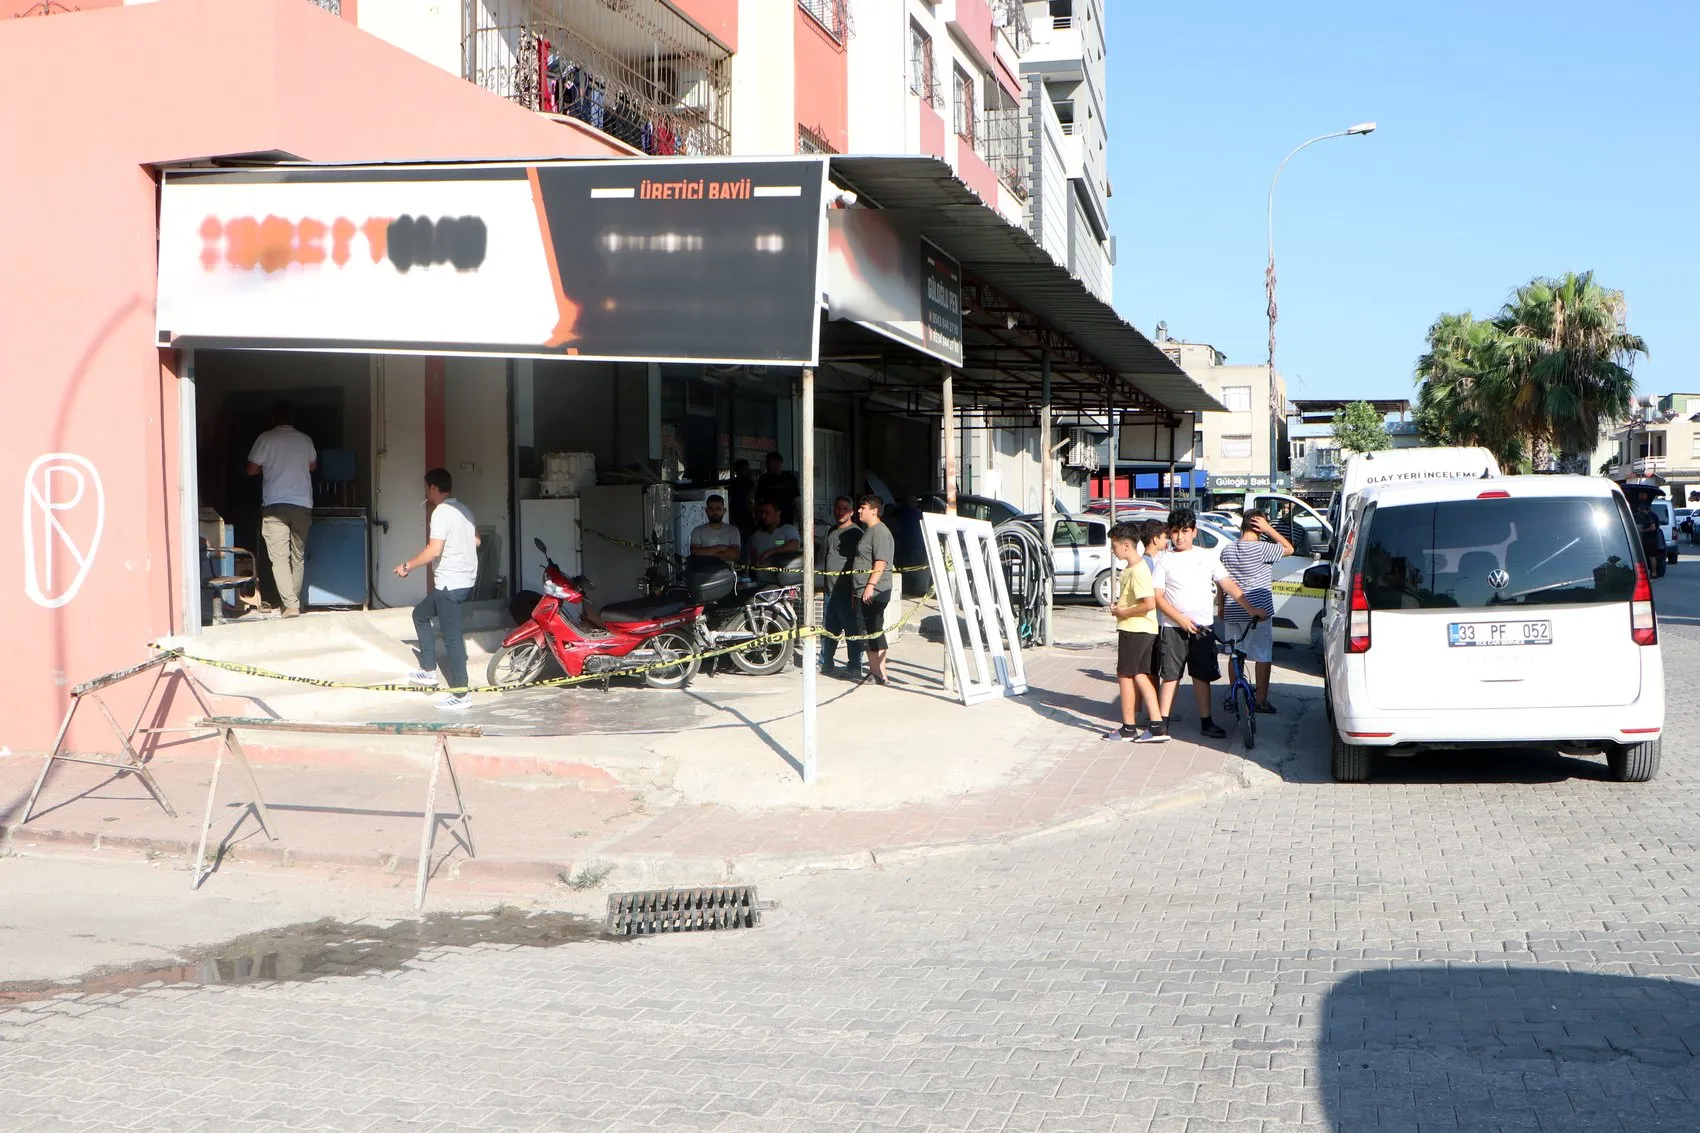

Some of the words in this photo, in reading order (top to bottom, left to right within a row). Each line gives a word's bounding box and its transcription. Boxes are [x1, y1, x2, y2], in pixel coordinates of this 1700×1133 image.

[640, 180, 703, 199] ÜRETİCİ
[709, 179, 750, 199] BAYİİ
[1367, 474, 1393, 484] OLAY
[1459, 625, 1475, 640] 33
[1490, 624, 1506, 640] PF
[1523, 623, 1548, 639] 052
